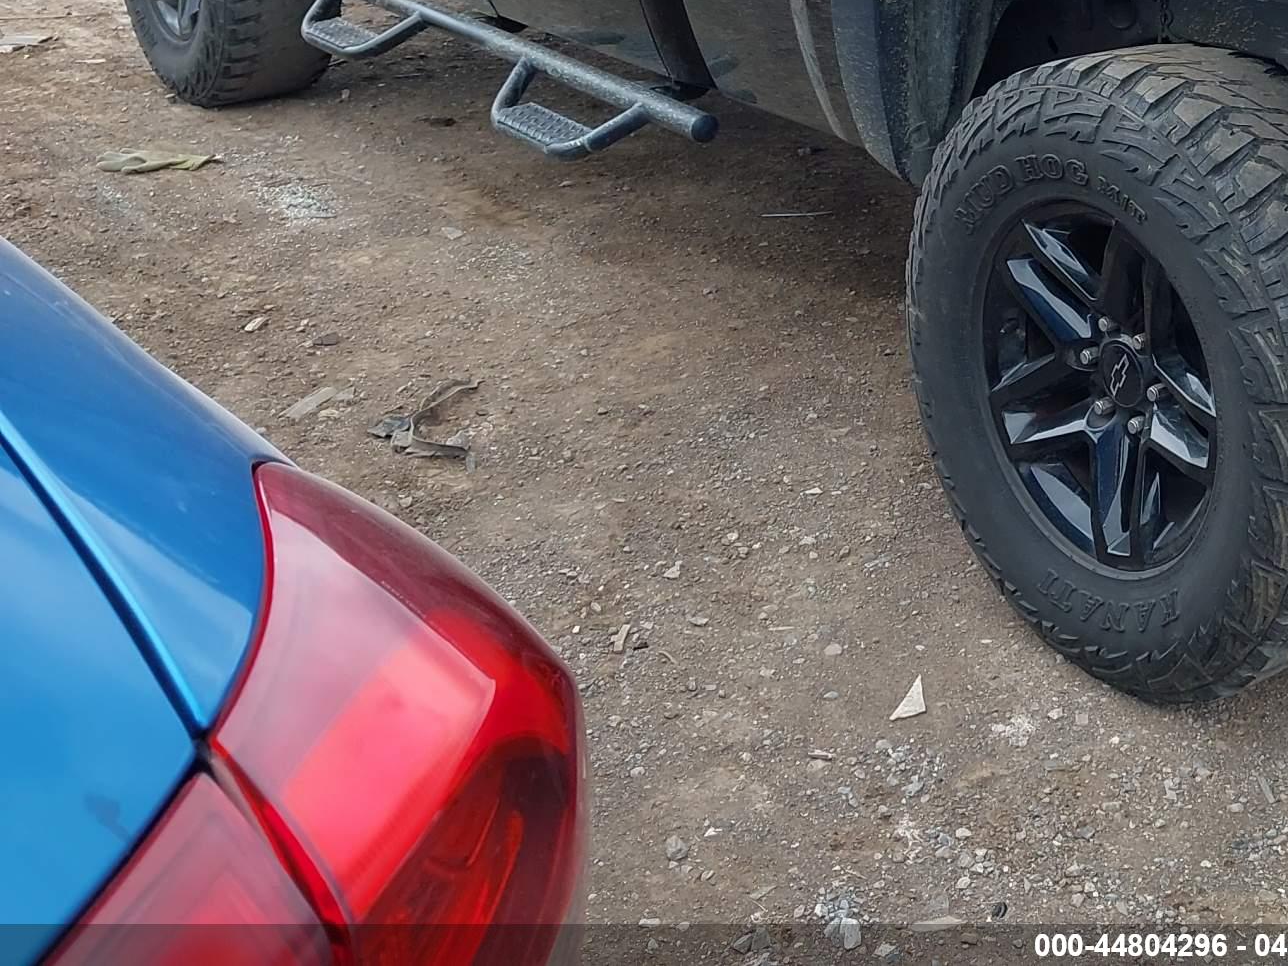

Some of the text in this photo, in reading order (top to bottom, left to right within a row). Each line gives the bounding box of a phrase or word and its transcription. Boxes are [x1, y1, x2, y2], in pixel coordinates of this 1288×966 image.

[953, 163, 1017, 236] MUD
[1013, 152, 1090, 187] HOG
[1035, 566, 1182, 634] KANATI
